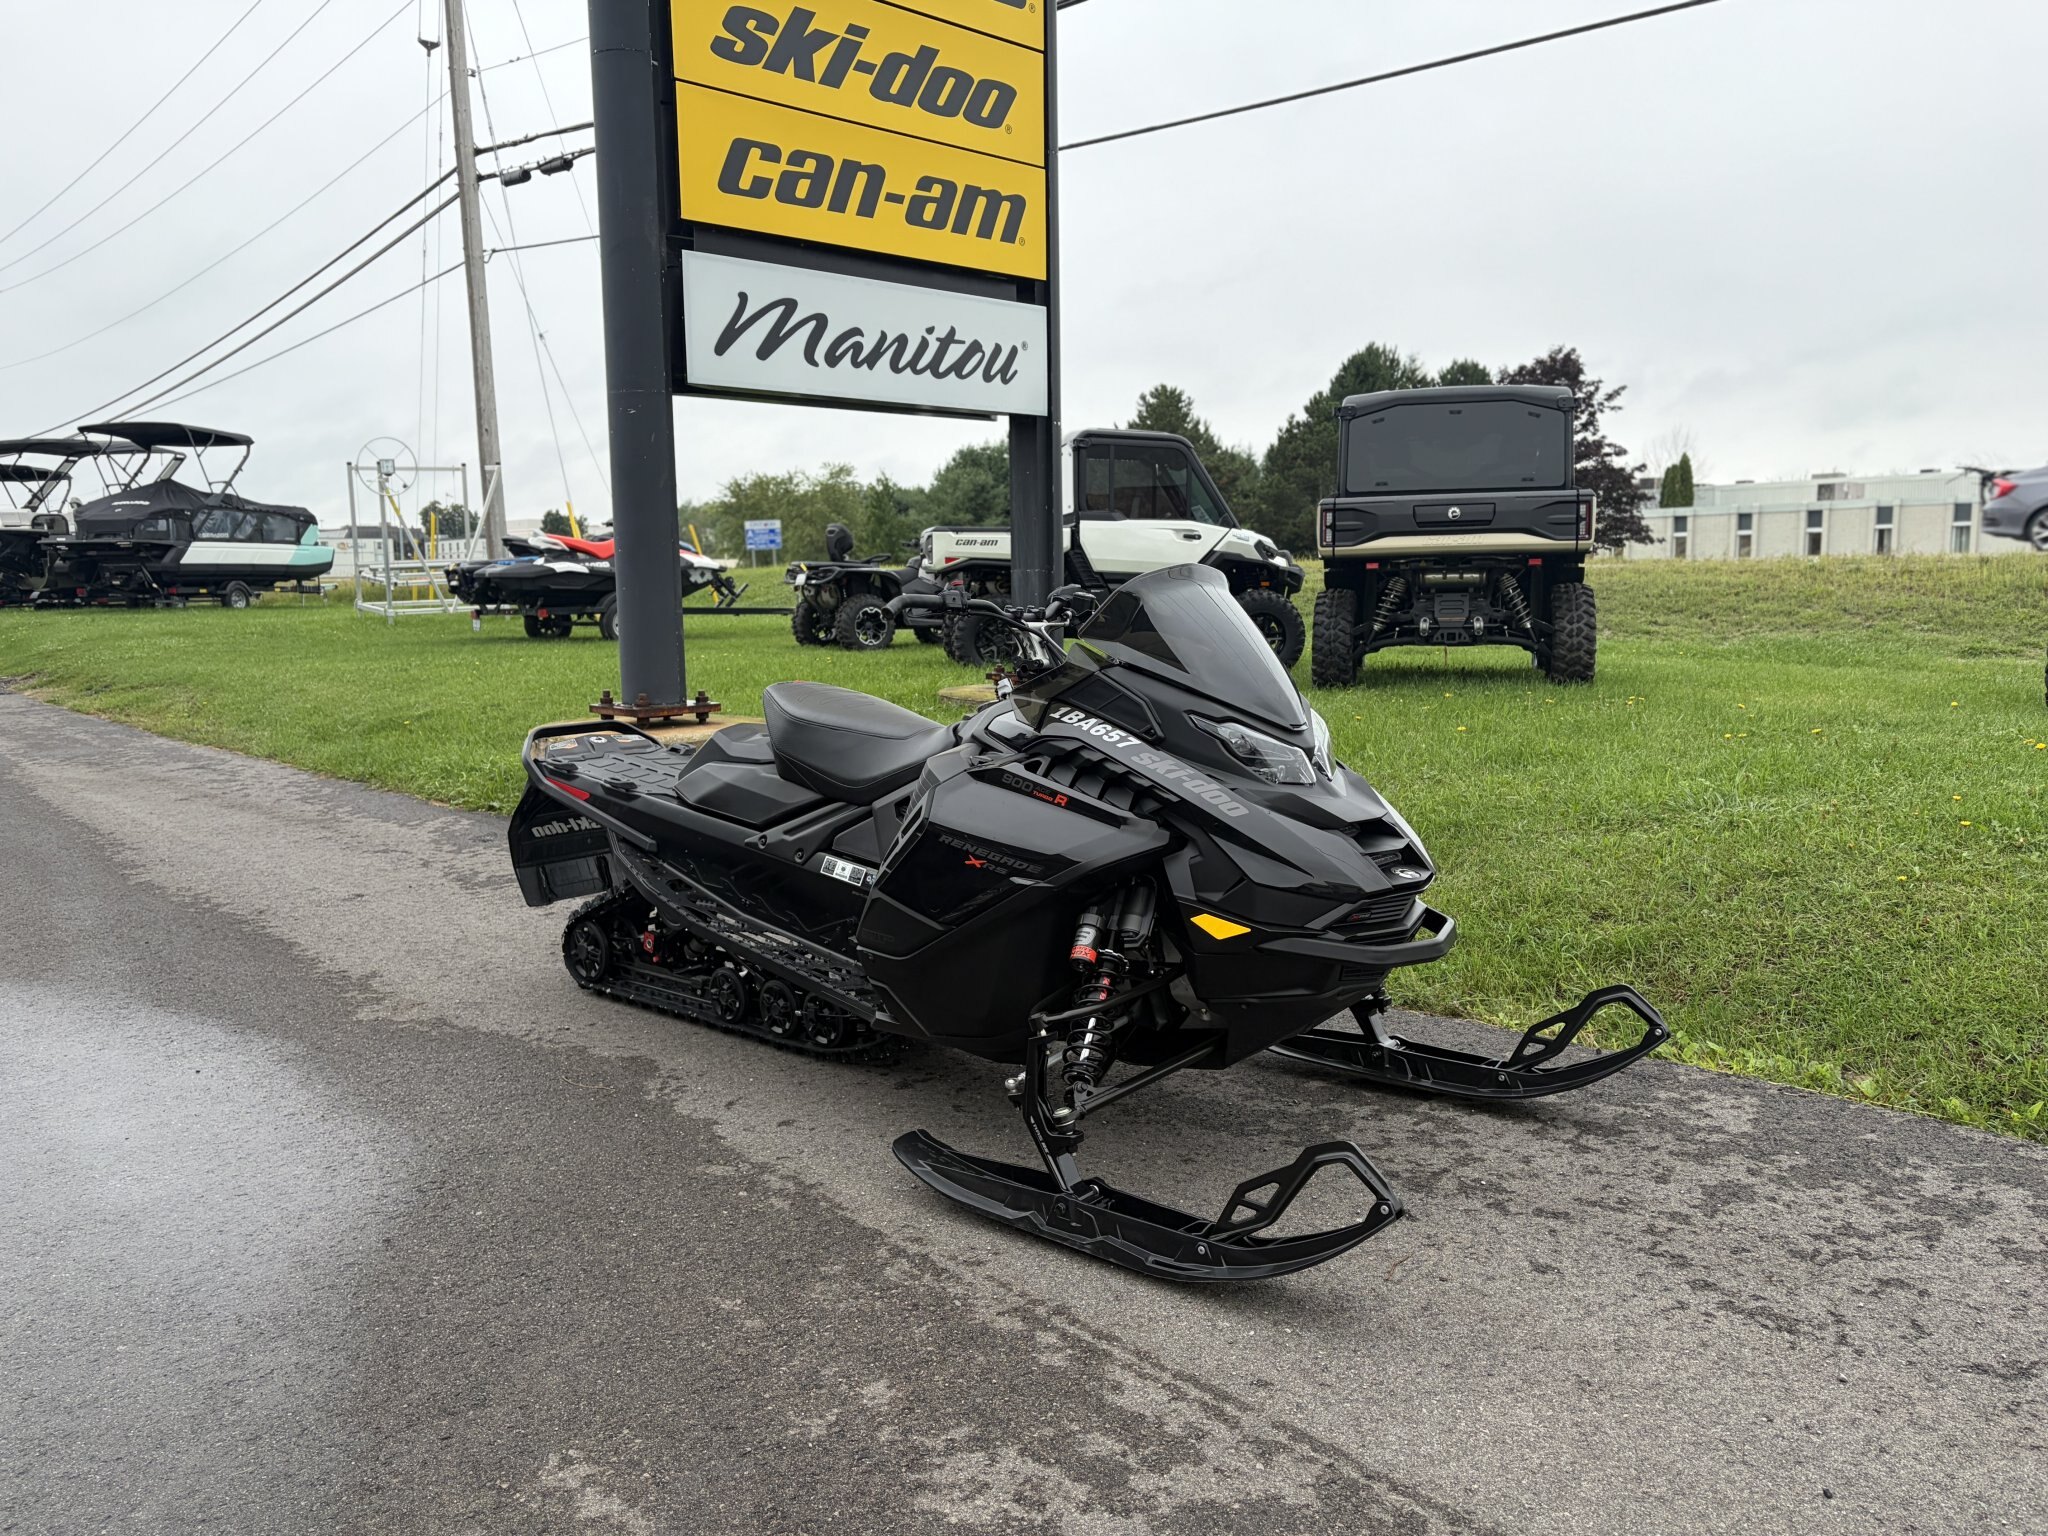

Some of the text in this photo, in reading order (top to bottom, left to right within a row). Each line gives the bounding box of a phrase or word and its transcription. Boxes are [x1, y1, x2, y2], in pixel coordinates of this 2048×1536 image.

[710, 5, 1017, 129] ski-doo
[717, 137, 1027, 245] can-am
[713, 291, 1019, 385] Manitou
[1049, 706, 1142, 748] 1BA657
[1002, 773, 1034, 792] 900
[1054, 793, 1069, 807] R
[1130, 752, 1249, 817] ski-doo
[939, 834, 1044, 874] RENEGADE
